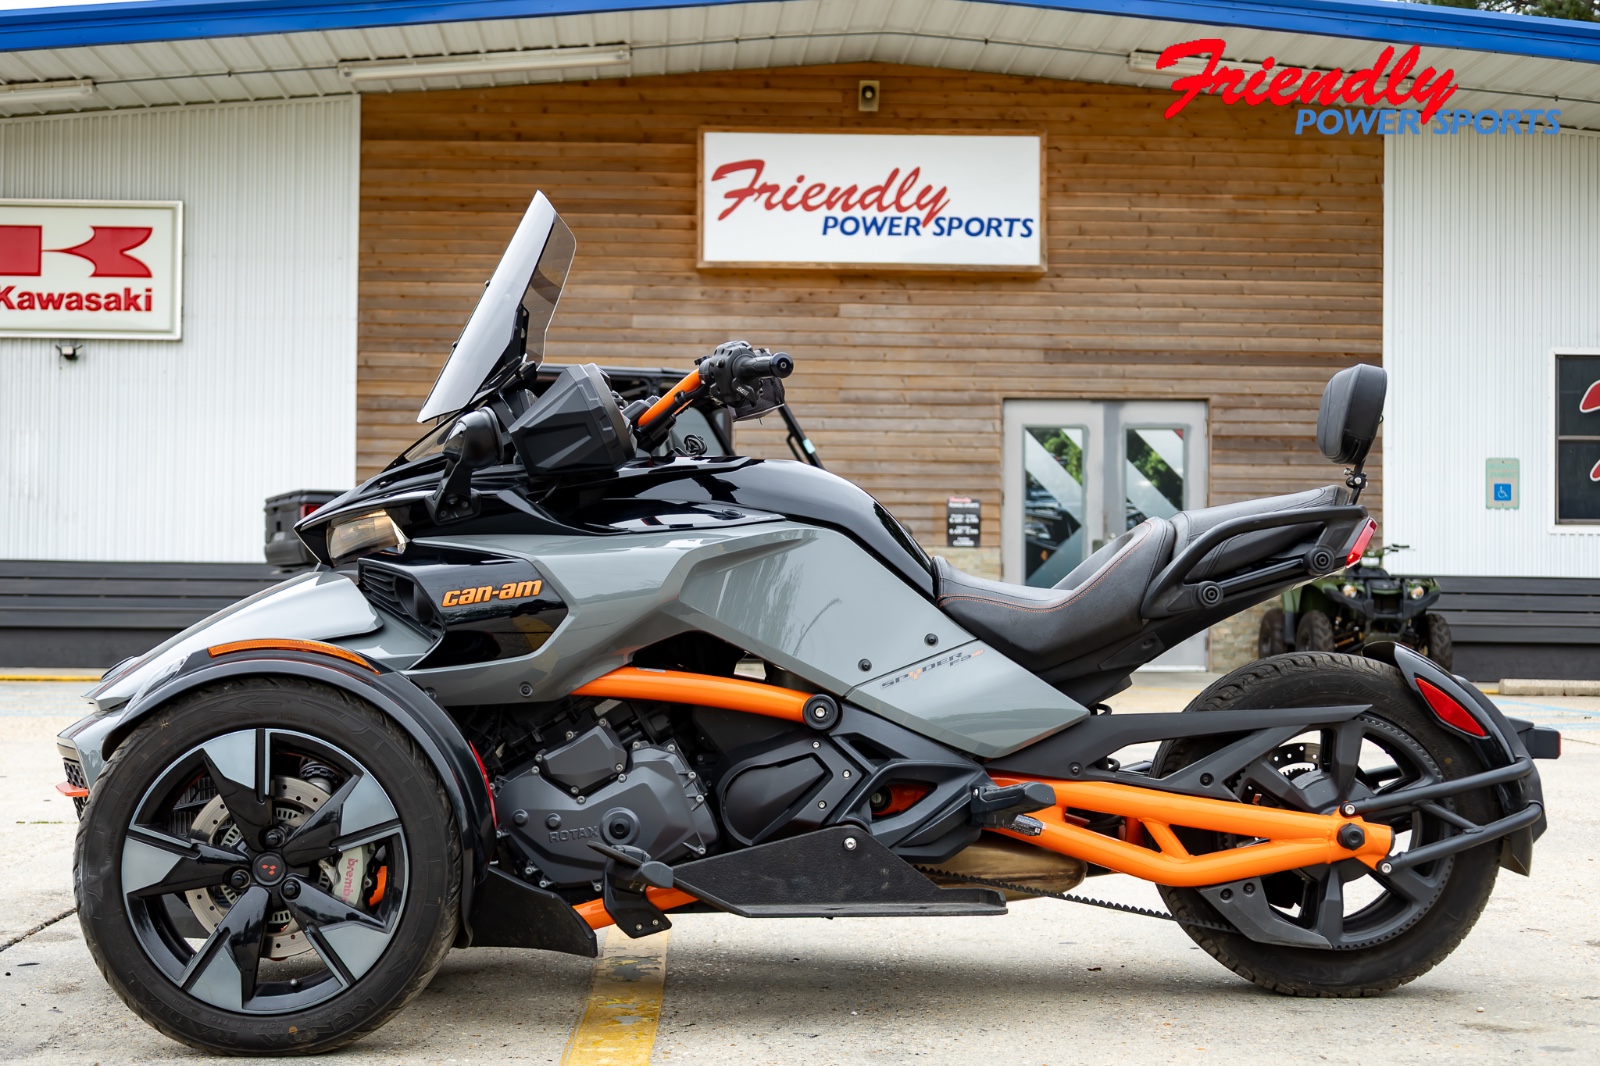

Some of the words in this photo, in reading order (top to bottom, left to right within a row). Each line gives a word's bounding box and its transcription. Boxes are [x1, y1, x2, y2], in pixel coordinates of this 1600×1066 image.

[711, 159, 950, 228] Friendly
[821, 216, 921, 236] POWER
[932, 216, 1034, 238] SPORTS
[0, 285, 153, 312] Kawasaki
[442, 580, 542, 607] can-am
[548, 825, 599, 843] ROTAX
